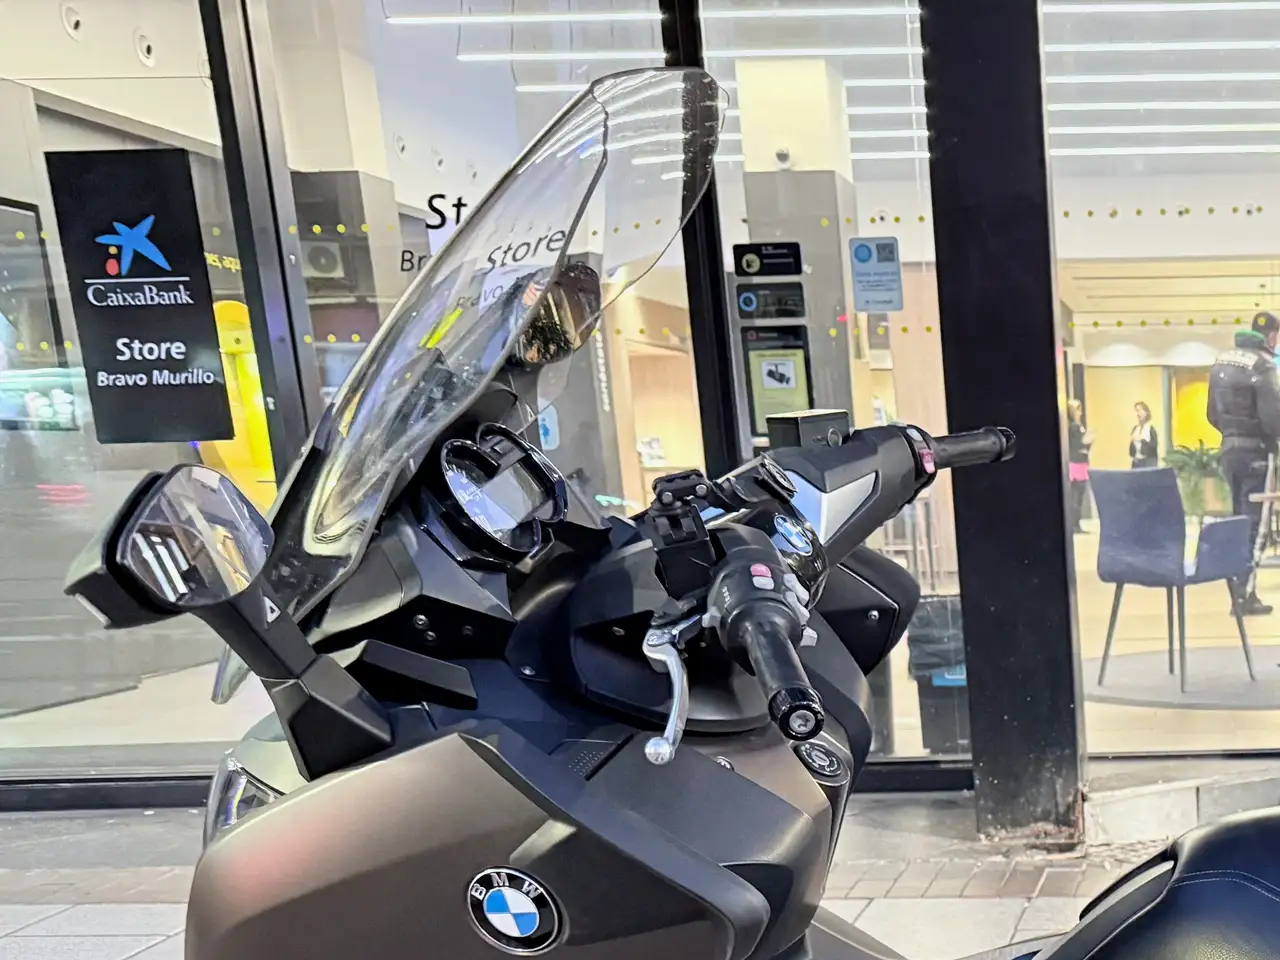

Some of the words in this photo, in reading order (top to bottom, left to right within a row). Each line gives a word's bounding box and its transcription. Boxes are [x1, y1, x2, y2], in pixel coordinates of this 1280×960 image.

[86, 284, 195, 307] CaixaBank
[115, 337, 187, 361] Store
[96, 371, 148, 387] Bravo
[152, 367, 215, 385] Murillo
[470, 872, 542, 901] BMW
